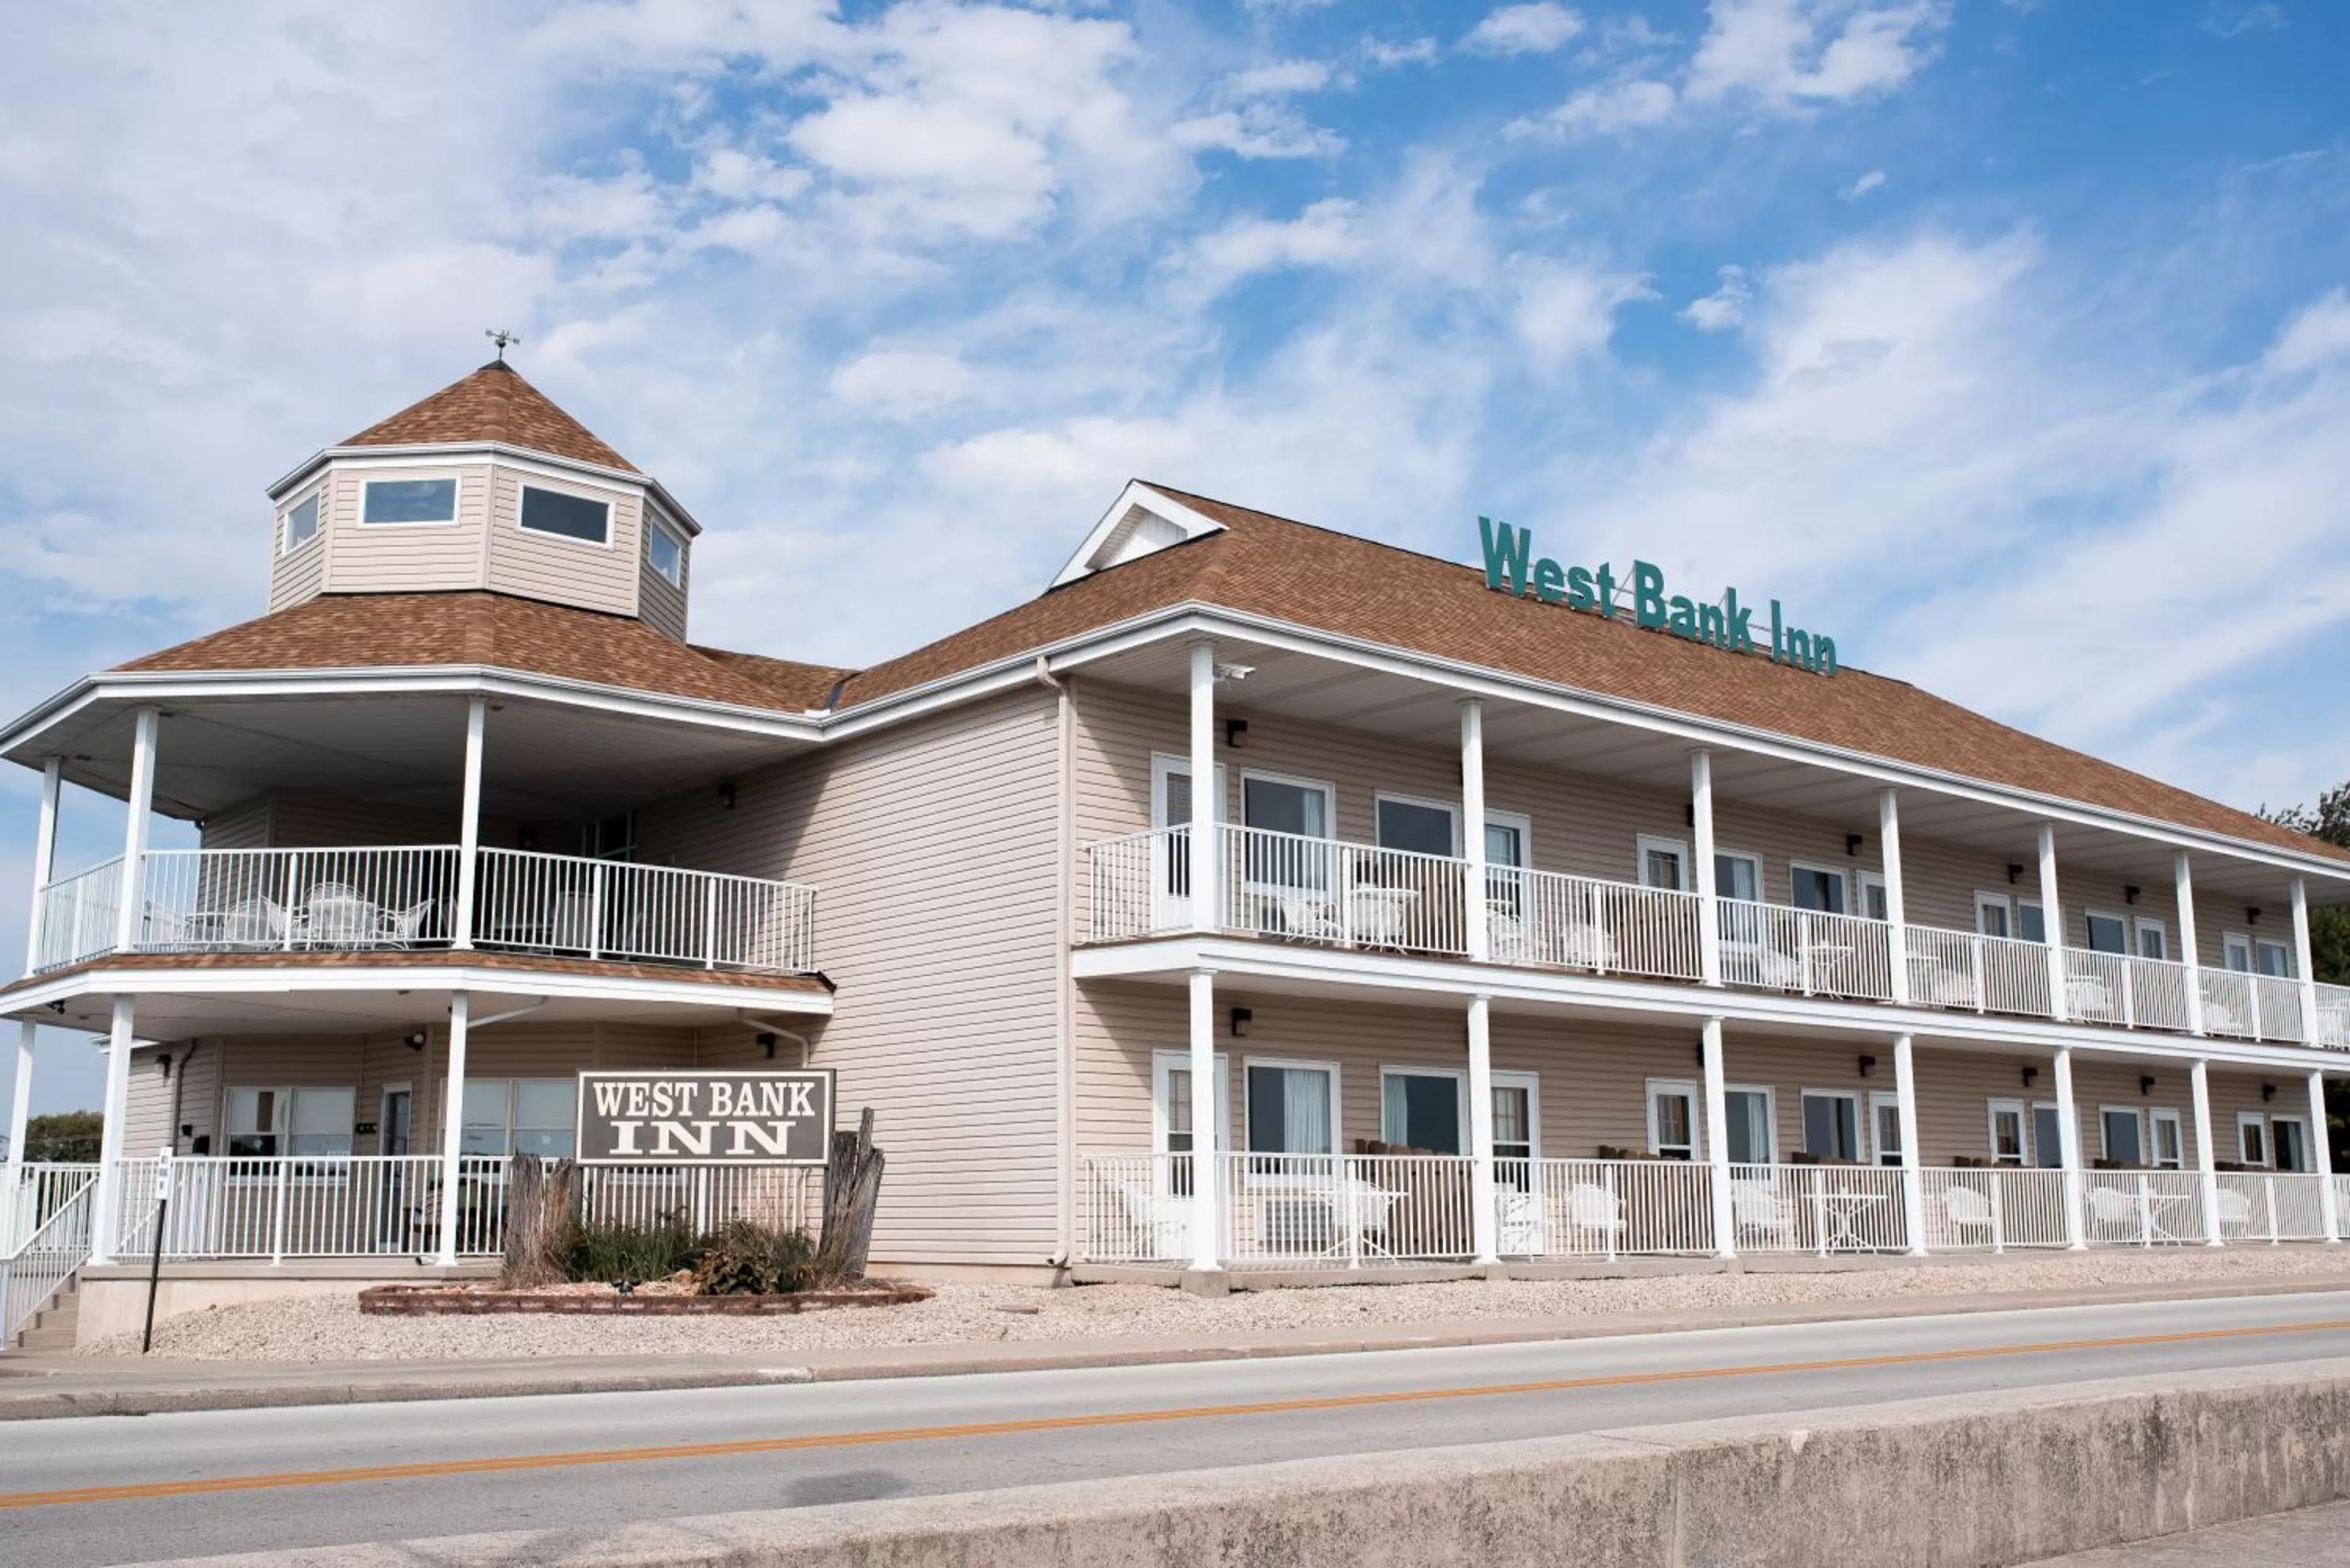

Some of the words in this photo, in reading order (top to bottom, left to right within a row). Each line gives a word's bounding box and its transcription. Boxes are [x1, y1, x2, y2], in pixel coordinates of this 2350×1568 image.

[1478, 515, 1616, 617] West
[1633, 560, 1753, 653] Bank
[1770, 598, 1838, 677] Inn
[593, 1082, 698, 1118] WEST
[709, 1082, 815, 1117] BANK
[609, 1121, 796, 1155] INN
